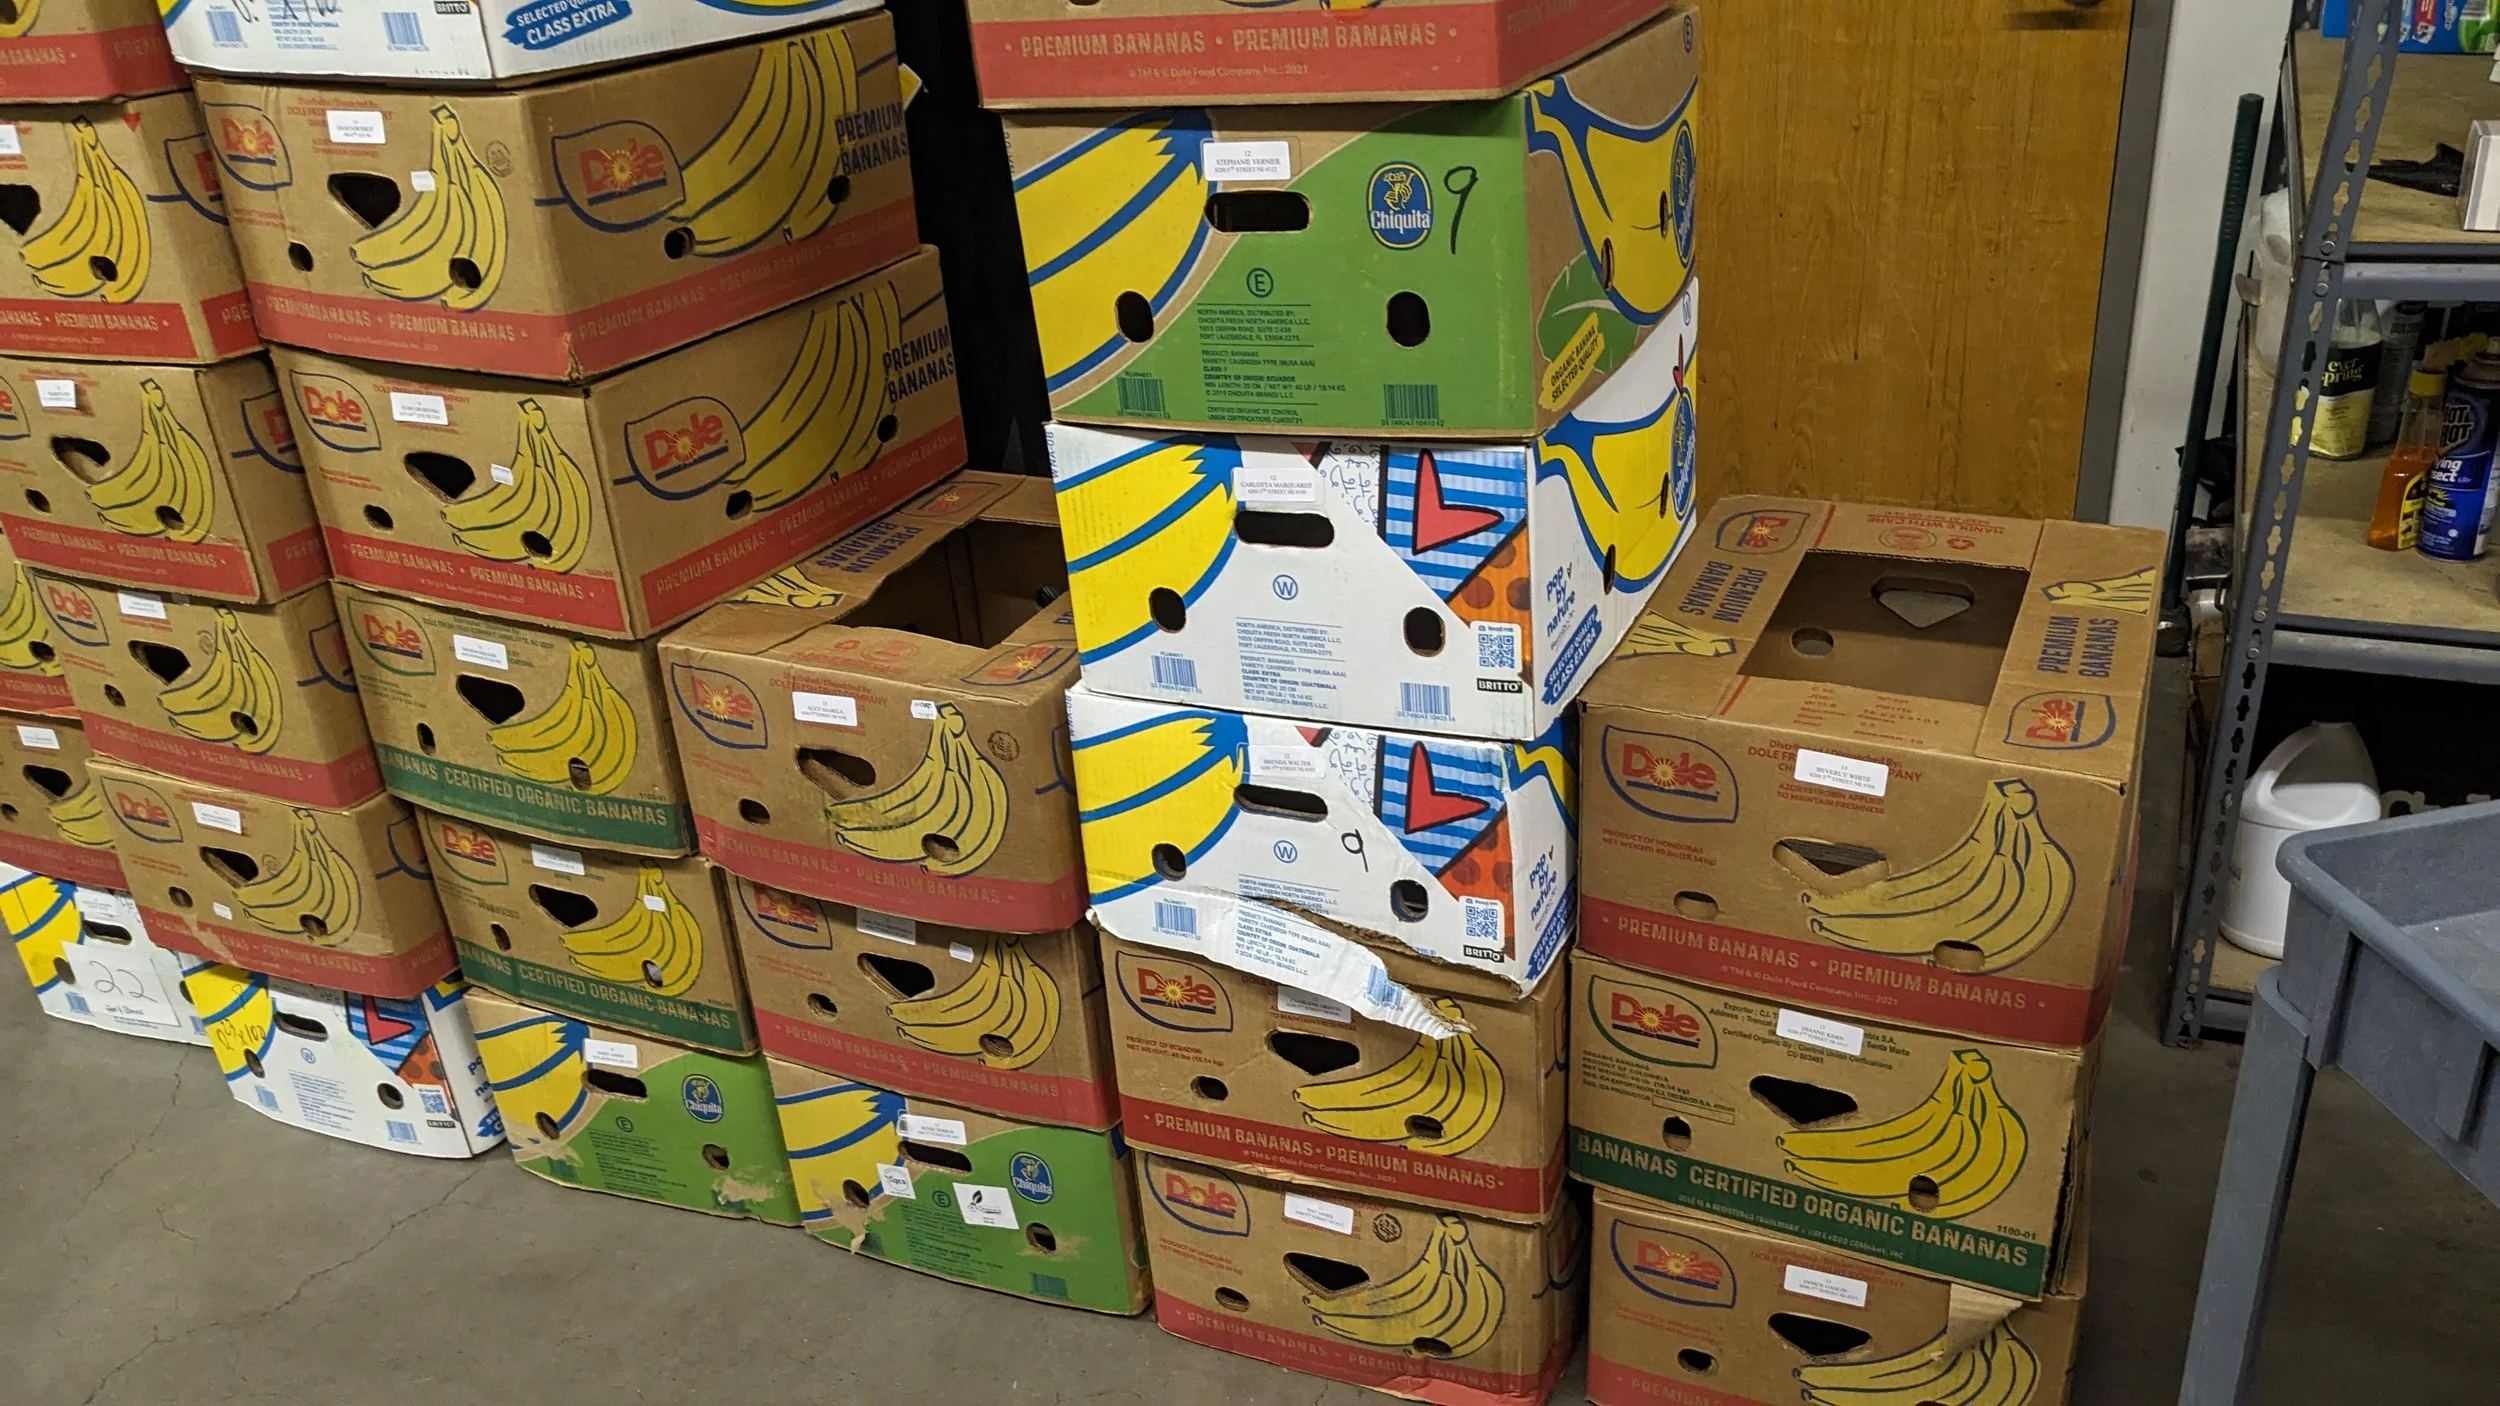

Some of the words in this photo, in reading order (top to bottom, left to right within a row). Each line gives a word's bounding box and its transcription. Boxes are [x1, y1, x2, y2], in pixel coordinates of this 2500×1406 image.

[516, 1, 569, 27] SELECTED
[527, 17, 568, 45] CLASS
[571, 3, 618, 34] EXTRA
[1021, 34, 1108, 57] PREMIUM
[1113, 30, 1205, 55] BANANAS
[1233, 27, 1329, 52] PREMIUM
[1335, 22, 1436, 49] BANANAS
[834, 108, 906, 146] PREMIUM
[579, 138, 668, 197] Dole
[840, 135, 909, 177] BANANAS
[1216, 158, 1251, 166] STEPHANIE
[1371, 209, 1432, 236] Chiquita
[1444, 166, 1478, 255] 9
[1254, 273, 1266, 292] E
[105, 314, 159, 331] BANANAS
[389, 313, 451, 337] PREMIUM
[451, 318, 516, 342] BANANAS
[578, 307, 644, 341] PREMIUM
[645, 286, 706, 325] BANANAS
[882, 325, 951, 372] PREMIUM
[887, 355, 955, 403] BANANAS
[1550, 351, 1577, 387] ORGANIC
[1551, 365, 1580, 403] SELECTED
[1578, 337, 1600, 371] QUALITY
[303, 385, 364, 423] Dole
[644, 411, 724, 471] Dole
[779, 501, 825, 535] PREMIUM
[1867, 516, 1904, 525] CARE
[117, 542, 166, 562] PREMIUM
[167, 547, 219, 568] BANANAS
[350, 543, 402, 568] PREMIUM
[401, 552, 456, 577] BANANAS
[656, 559, 713, 595] PREMIUM
[715, 531, 766, 570] BANANAS
[816, 521, 899, 570] BANANAS
[842, 525, 924, 574] PREMIUM
[470, 564, 525, 589] PREMIUM
[527, 574, 585, 600] BANANAS
[1276, 581, 1293, 597] W
[1547, 565, 1564, 601] pop
[1556, 579, 1567, 601] by
[1678, 560, 1732, 617] BANANAS
[1712, 568, 1767, 624] PREMIUM
[48, 585, 93, 620] Dole
[1546, 590, 1576, 638] nature
[364, 613, 422, 653] Dole
[1302, 634, 1327, 642] AMERICA
[1548, 640, 1577, 686] SELECTED
[1573, 611, 1598, 649] QUALITY
[2036, 615, 2080, 674] PREMIUM
[2078, 618, 2120, 679] BANANAS
[1552, 661, 1577, 699] CLASS
[1573, 629, 1598, 668] EXTRA
[1479, 680, 1520, 693] BRITTO
[2026, 698, 2078, 744] Dole
[1622, 742, 1717, 794] Dole
[1748, 746, 1780, 760] DOLE
[1816, 766, 1849, 778] BEVERLY
[1849, 772, 1872, 782] WHITE
[444, 766, 513, 799] CERTIFIED
[516, 784, 582, 814] ORGANIC
[586, 799, 668, 827] BANANAS
[1777, 790, 1789, 799] TO
[1790, 791, 1834, 807] MAINTAIN
[1835, 799, 1886, 815] FRESHNESS
[441, 823, 497, 863] Dole
[1277, 843, 1294, 858] W
[1602, 828, 1643, 841] PRODUCT
[1643, 836, 1655, 844] OF
[1656, 839, 1704, 855] HONDURAS
[772, 848, 839, 874] BANANAS
[1529, 853, 1546, 890] pop
[1538, 864, 1549, 888] by
[856, 866, 926, 892] PREMIUM
[927, 879, 999, 904] BANANAS
[1530, 870, 1557, 921] nature
[1465, 946, 1502, 960] BRITTO
[1617, 915, 1705, 951] PREMIUM
[1708, 934, 1801, 970] BANANAS
[88, 960, 159, 1005] 22
[518, 963, 586, 996] CERTIFIED
[590, 983, 652, 1014] ORGANIC
[1137, 967, 1217, 1008] Dole
[1762, 973, 1783, 983] Dole
[1785, 977, 1807, 988] Food
[1809, 982, 1853, 998] Company,
[1875, 995, 1898, 1006] 2021
[1827, 959, 1923, 993] PREMIUM
[1927, 977, 2027, 1010] BANANAS
[1269, 1010, 1279, 1020] TO
[1280, 1012, 1313, 1027] MAINTAIN
[1313, 1017, 1357, 1032] FRESHNESS
[1611, 991, 1700, 1038] Dole
[1708, 1007, 1739, 1021] Address
[1746, 1014, 1773, 1027] Troncal
[1723, 1002, 1754, 1015] Exporter
[784, 1025, 844, 1057] PREMIUM
[843, 1039, 907, 1072] BANANAS
[1126, 1035, 1156, 1047] PRODUCT
[1169, 1043, 1202, 1055] ECUADOR
[1722, 1027, 1752, 1041] Certified
[1753, 1034, 1782, 1048] Organic
[1799, 1043, 1825, 1055] Control
[1826, 1049, 1848, 1060] Union
[1801, 1026, 1825, 1038] DIANNE
[1866, 1041, 1888, 1052] Santa
[923, 1061, 990, 1088] PREMIUM
[991, 1072, 1060, 1097] BANANAS
[1583, 1050, 1614, 1063] ORGANIC
[1614, 1057, 1650, 1072] BANANAS
[1583, 1057, 1615, 1070] PRODUCT
[1628, 1067, 1669, 1083] COLOMBIA
[1611, 1078, 1655, 1094] EXPORTADOR
[685, 1098, 724, 1116] Chiquita
[1154, 1112, 1231, 1141] PREMIUM
[1235, 1128, 1314, 1156] BANANAS
[1012, 1174, 1054, 1196] Chiquita
[1326, 1146, 1408, 1173] PREMIUM
[1412, 1162, 1496, 1190] BANANAS
[1165, 1173, 1238, 1213] Dole
[1577, 1135, 1678, 1178] BANANAS
[1689, 1165, 1798, 1210] CERTIFIED
[1804, 1194, 1905, 1236] ORGANIC
[1911, 1222, 2028, 1267] BANANAS
[1996, 1224, 2037, 1240] 1100-01
[1187, 1310, 1256, 1340] PREMIUM
[1260, 1328, 1328, 1358] BANANAS
[1348, 1350, 1425, 1375] PREMIUM
